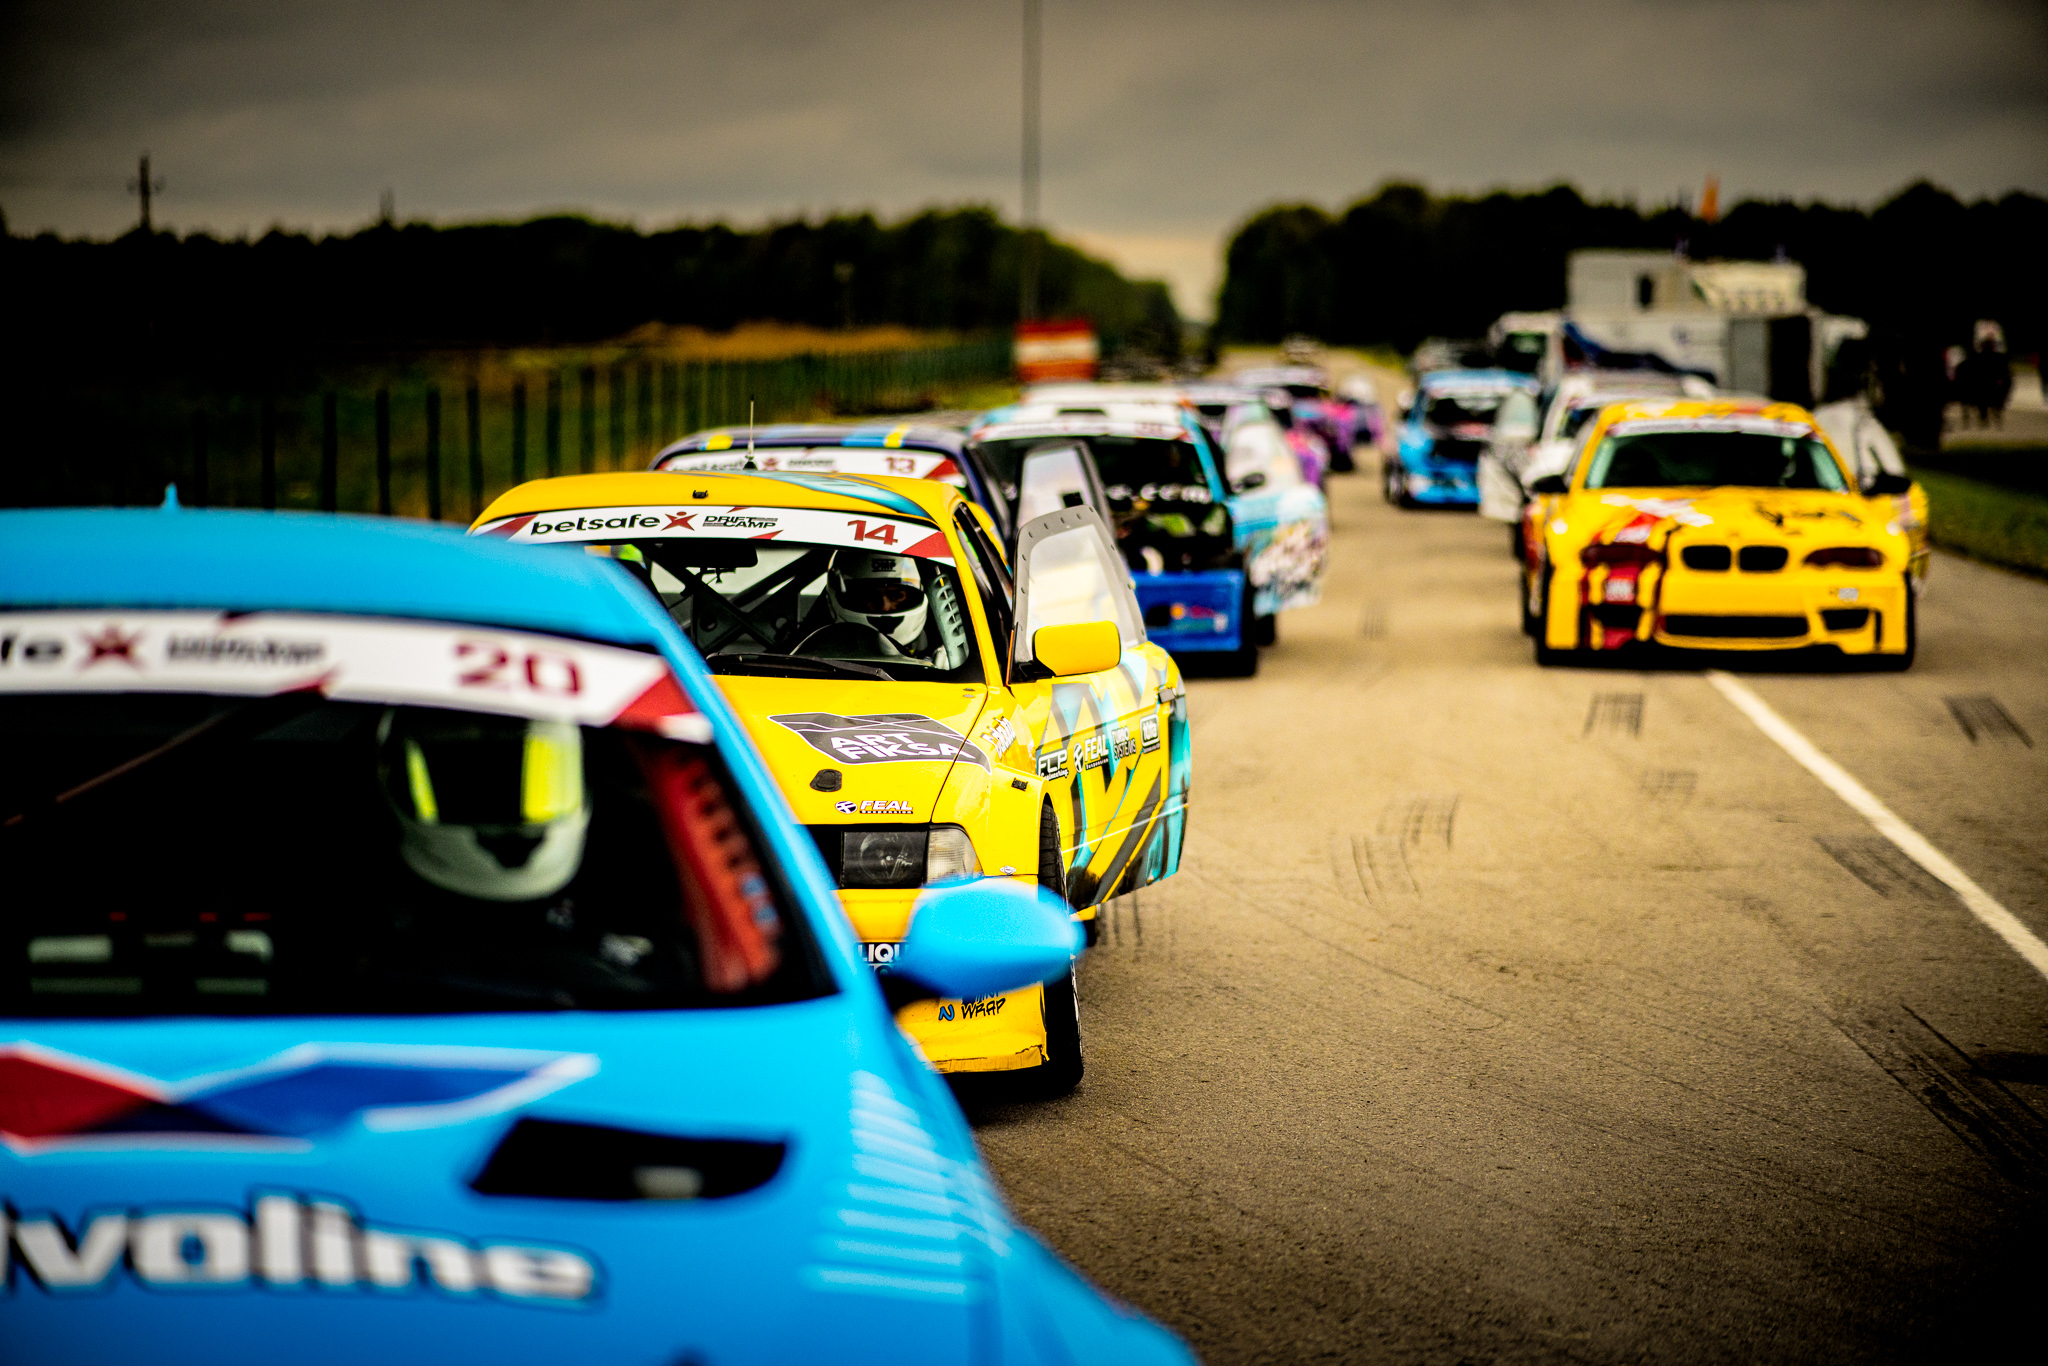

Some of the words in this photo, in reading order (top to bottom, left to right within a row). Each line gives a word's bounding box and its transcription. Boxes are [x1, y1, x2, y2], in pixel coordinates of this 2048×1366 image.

[531, 514, 661, 535] betsafe
[847, 520, 899, 545] 14
[455, 642, 582, 695] 20
[831, 733, 915, 748] ART
[836, 742, 977, 760] FIKSA
[1085, 734, 1109, 762] FEAL
[860, 801, 914, 810] FEAL
[961, 998, 1006, 1020] WRAP
[0, 1192, 597, 1300] voline
